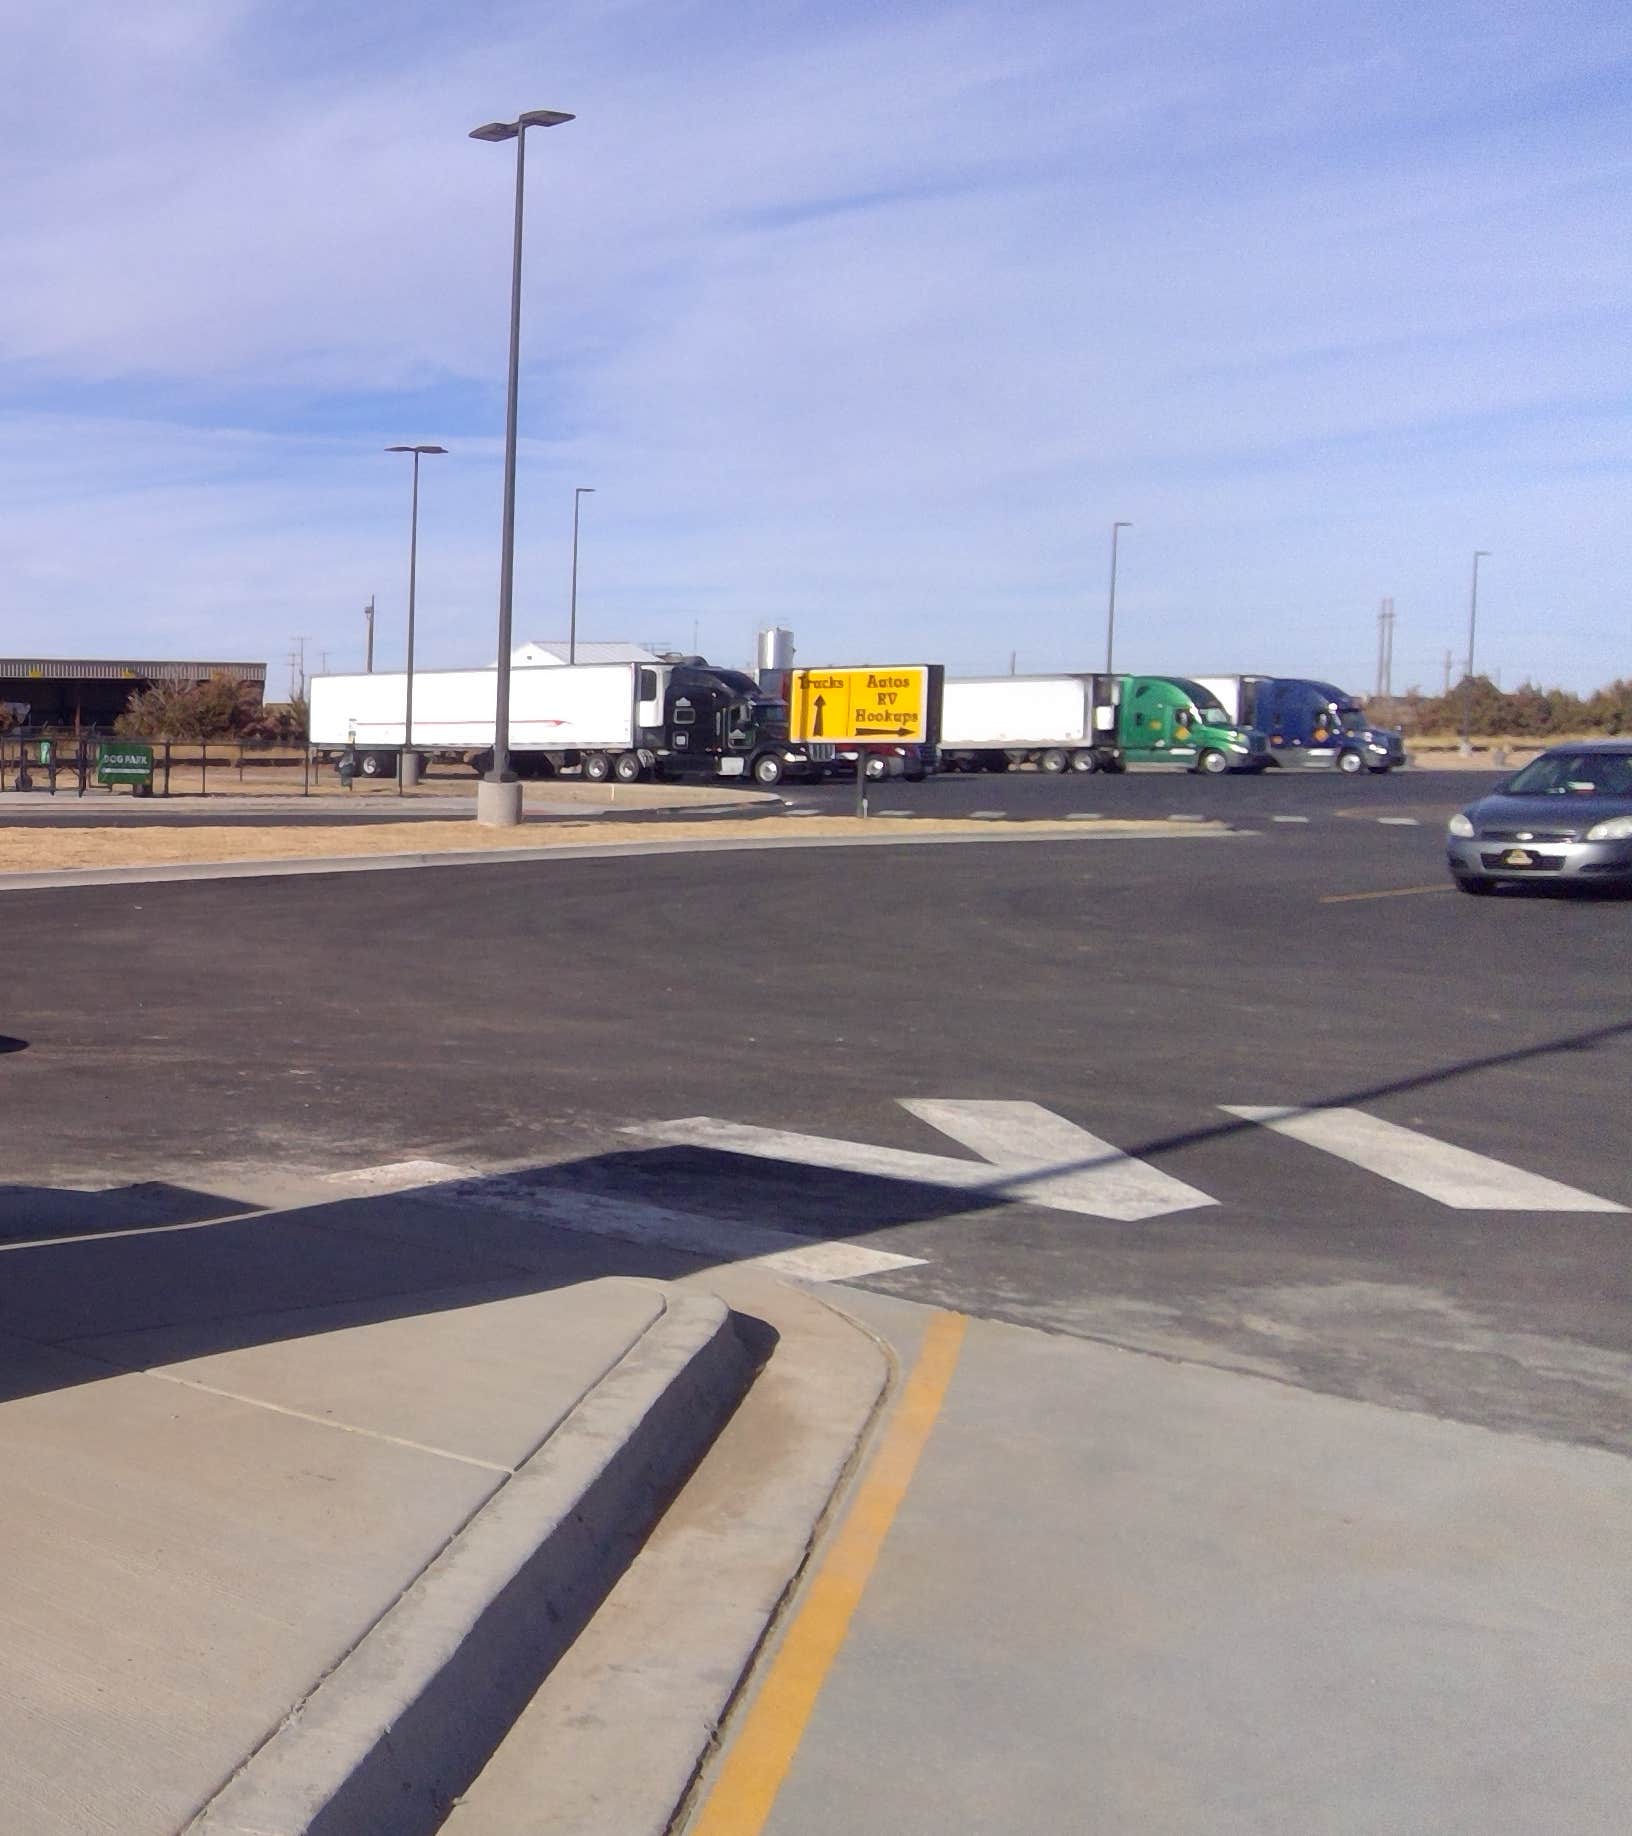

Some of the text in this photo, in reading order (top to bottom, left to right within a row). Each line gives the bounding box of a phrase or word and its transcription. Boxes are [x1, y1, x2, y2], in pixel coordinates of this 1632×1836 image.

[798, 675, 844, 690] Trucks
[867, 675, 910, 688] Autos
[877, 692, 898, 705] RV
[855, 709, 919, 726] Hookups
